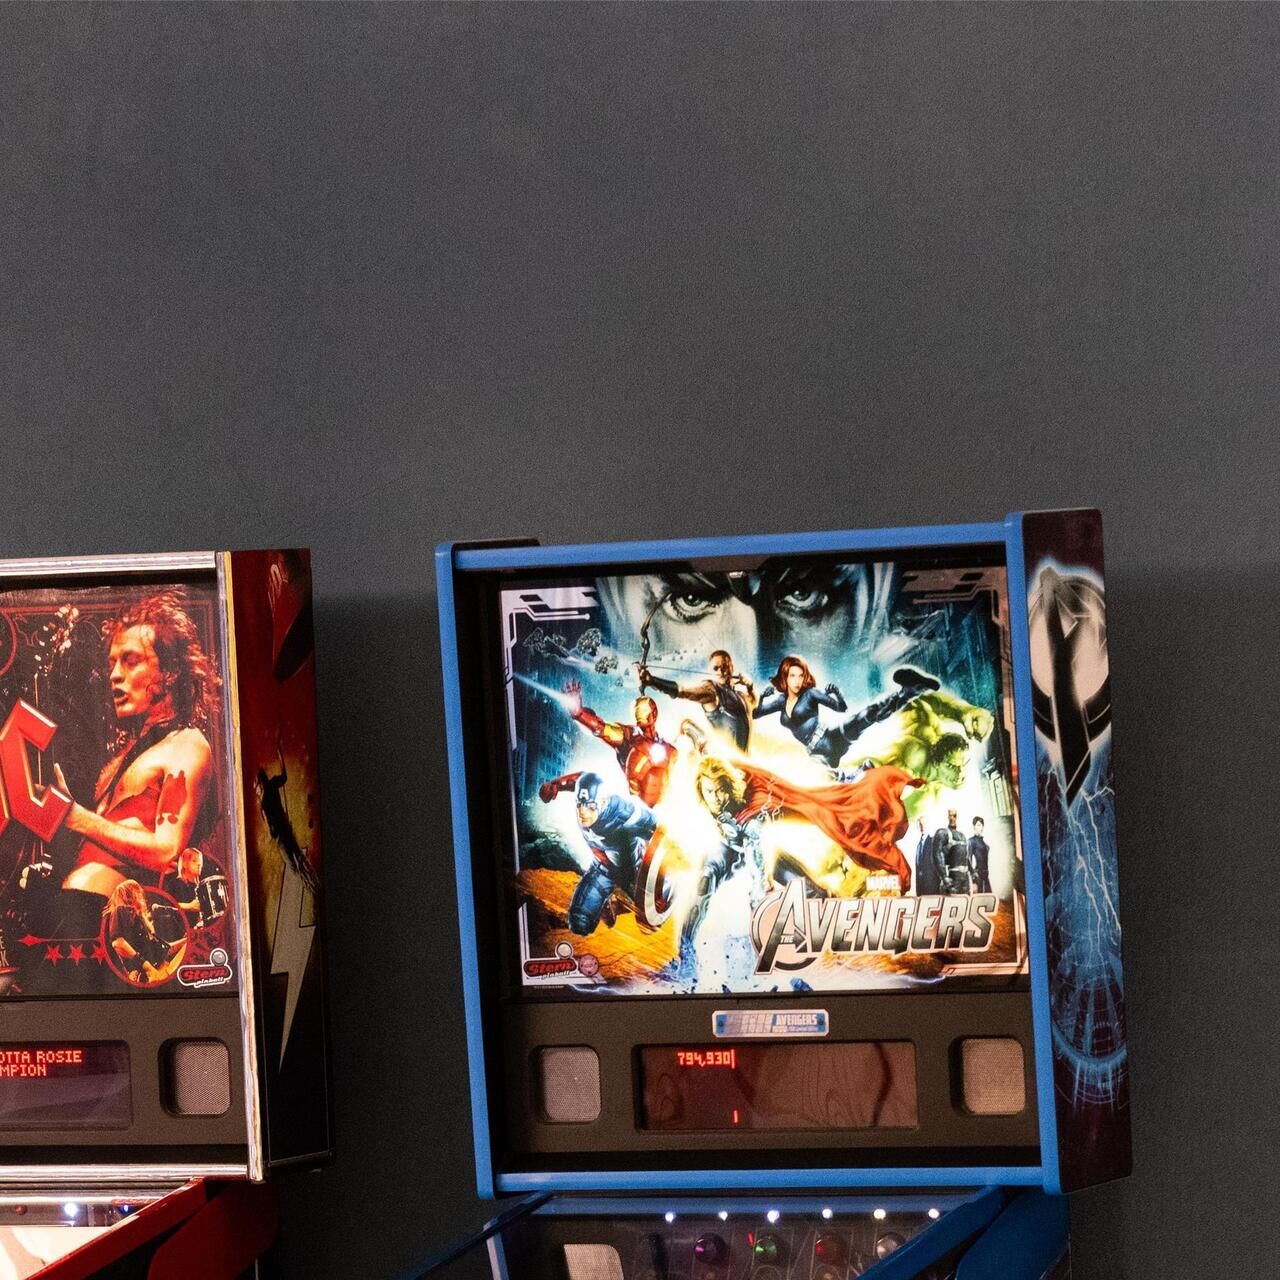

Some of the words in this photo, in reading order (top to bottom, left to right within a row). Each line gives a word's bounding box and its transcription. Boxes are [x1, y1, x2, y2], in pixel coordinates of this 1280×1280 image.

[751, 877, 997, 975] AVENGERS
[780, 934, 795, 944] THE
[36, 1050, 83, 1063] ROSIE
